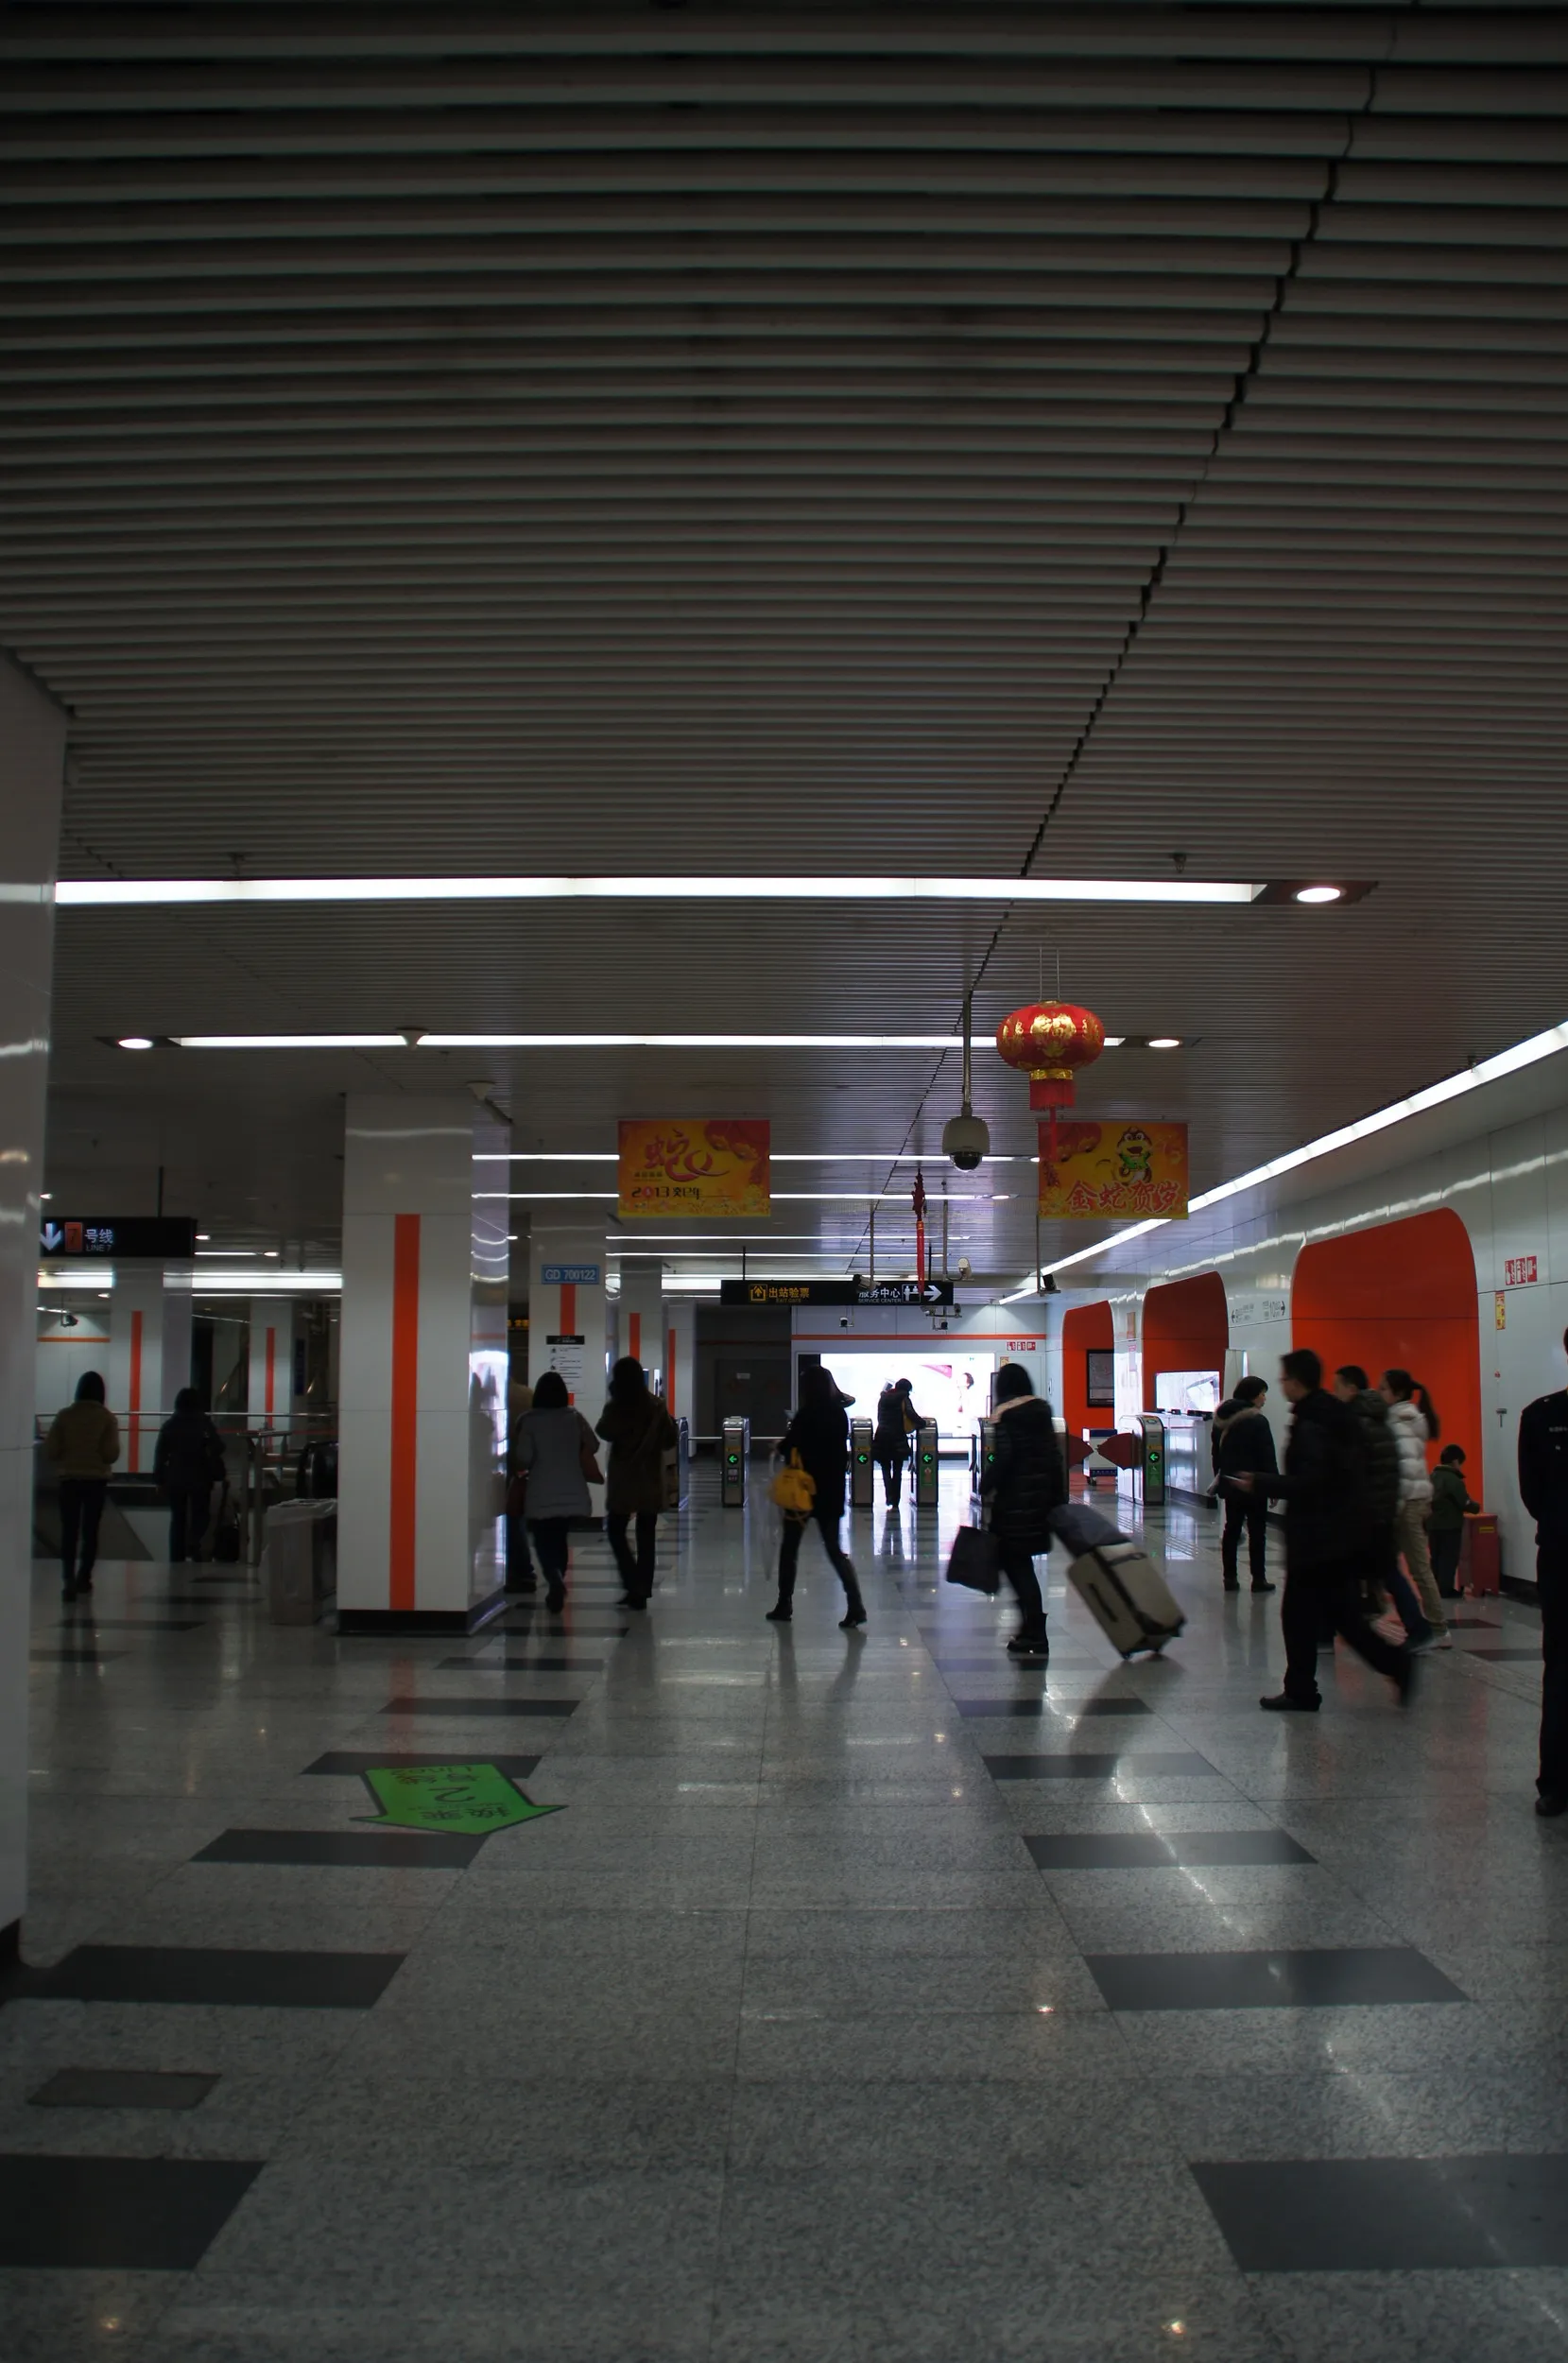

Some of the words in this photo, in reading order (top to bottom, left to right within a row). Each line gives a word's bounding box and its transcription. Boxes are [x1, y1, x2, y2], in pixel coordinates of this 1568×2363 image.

[1065, 1179, 1180, 1215] 金蛇贺岁
[84, 1228, 113, 1244] 号线
[86, 1244, 104, 1252] LINE
[545, 1268, 560, 1280] GD
[563, 1269, 595, 1280] 700122
[768, 1286, 810, 1299] 出站验票
[858, 1287, 901, 1299] 服务中心
[427, 1786, 476, 1802] 2
